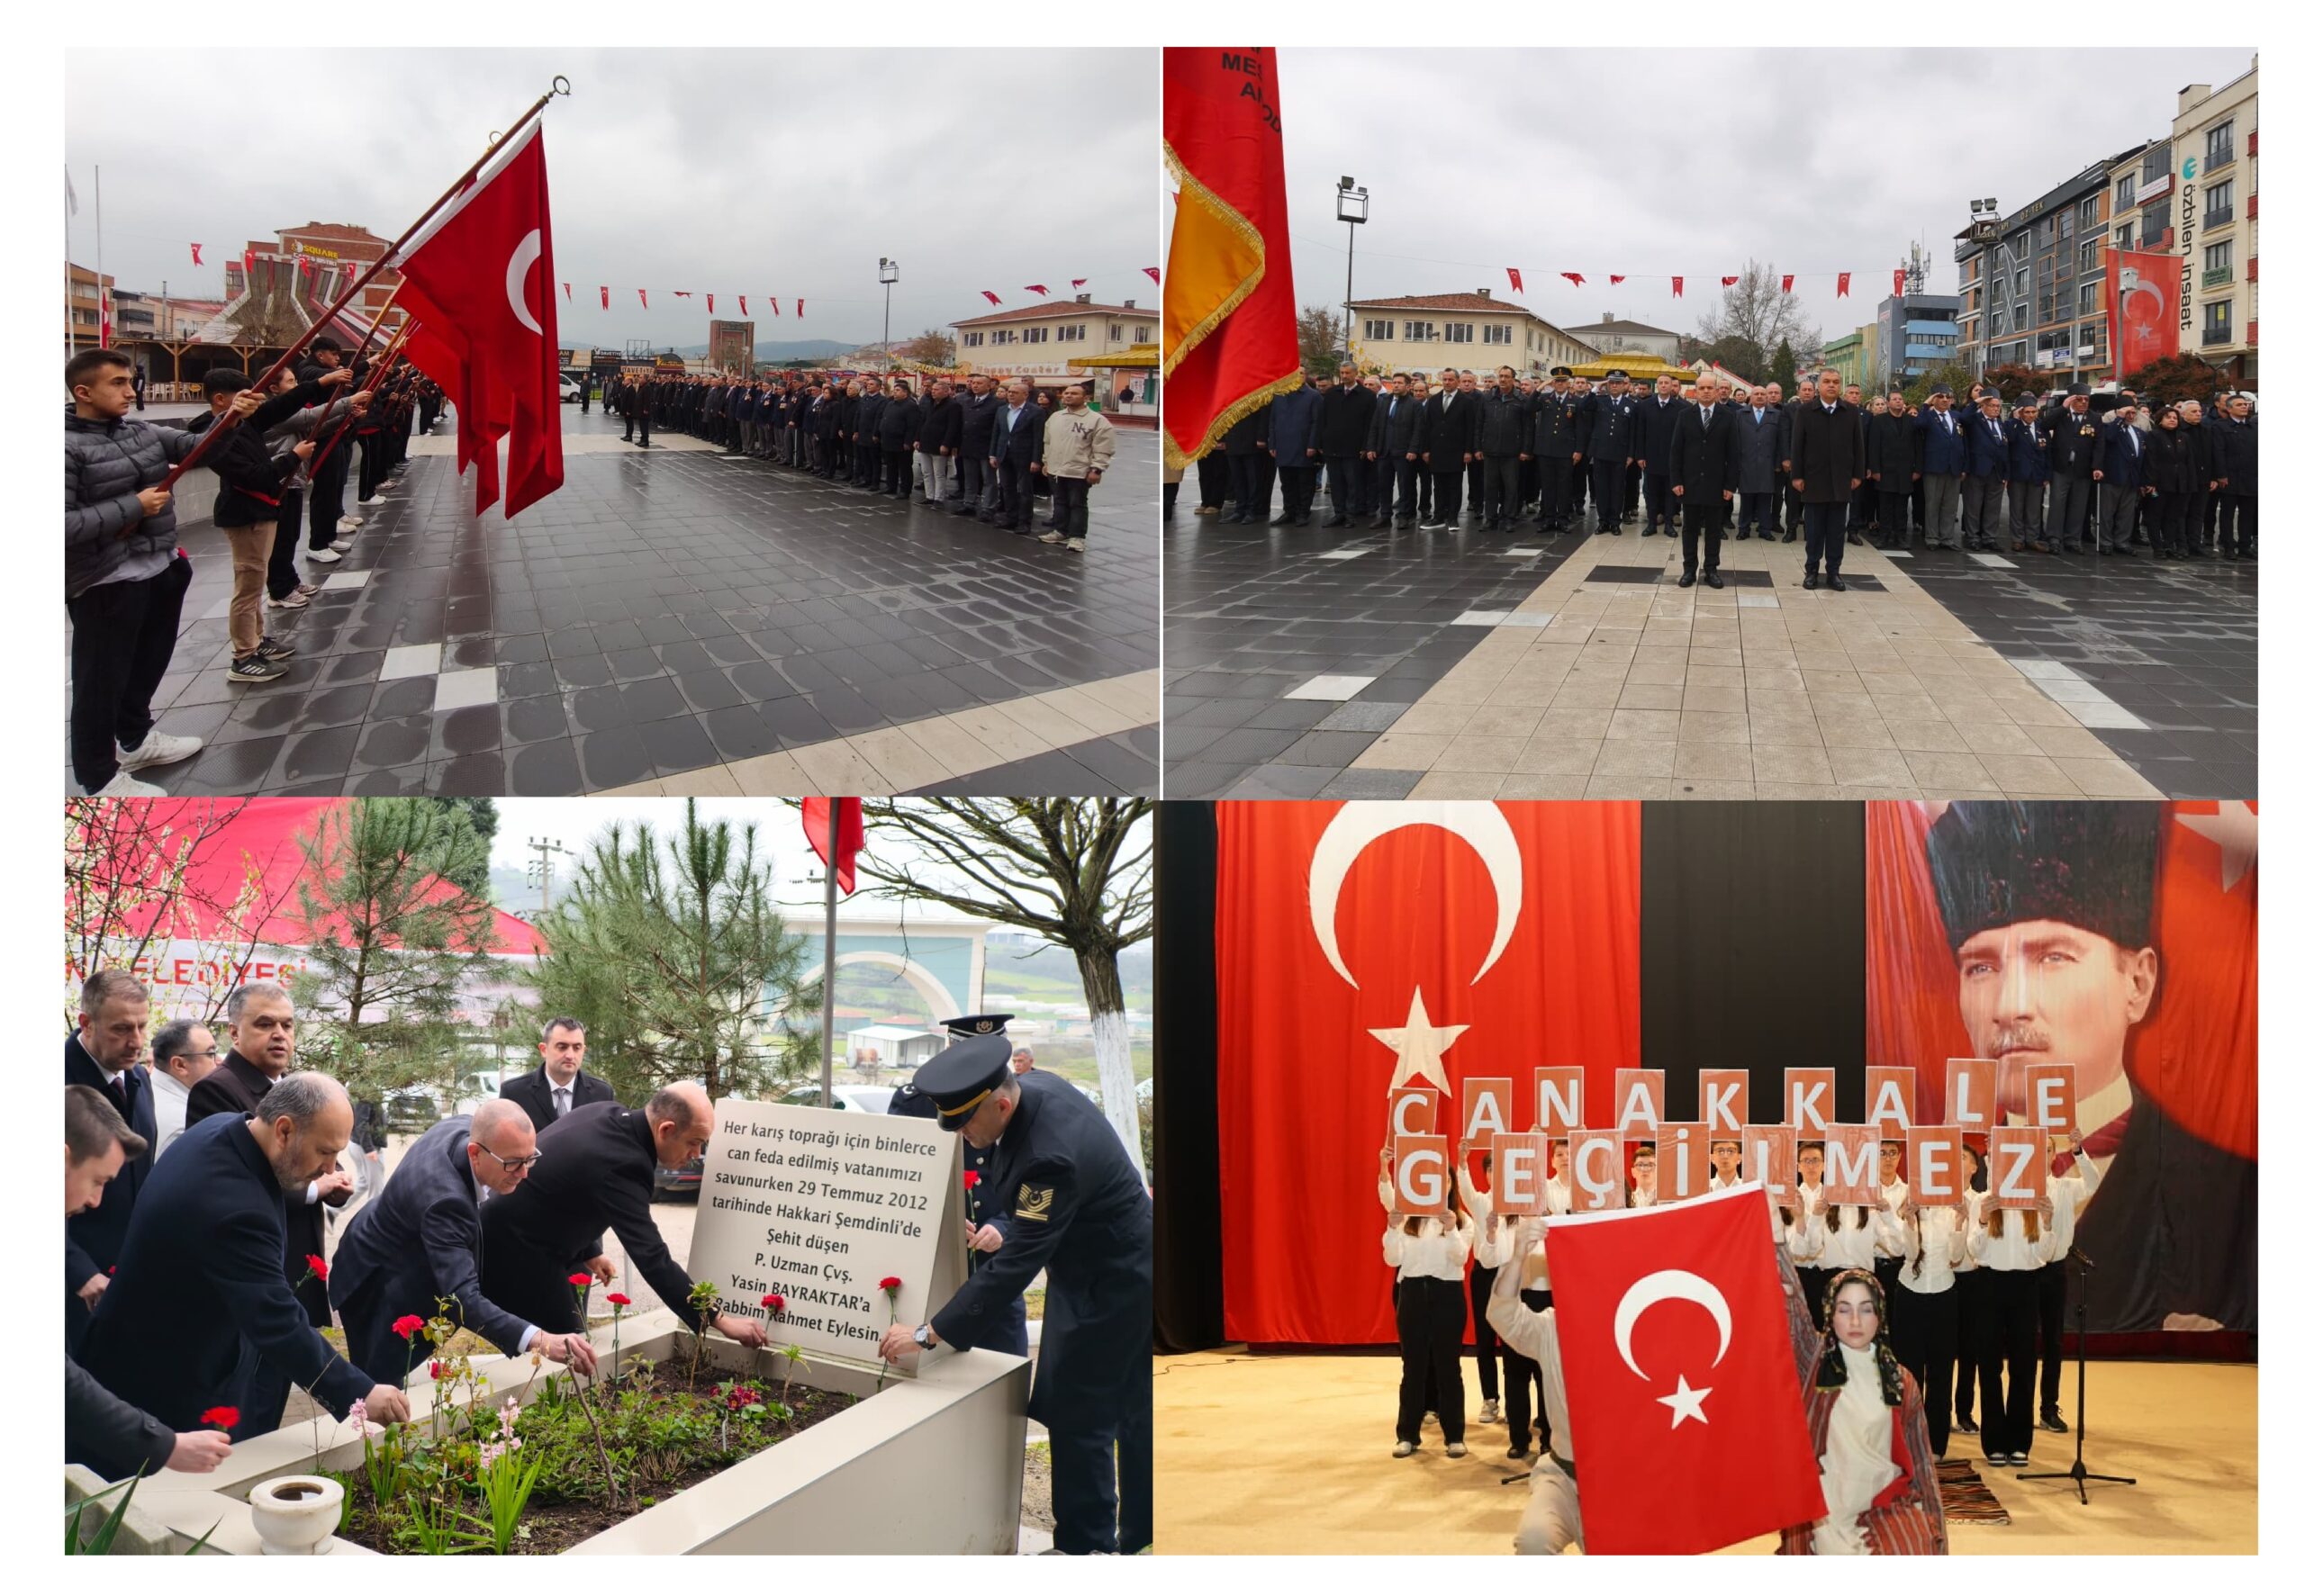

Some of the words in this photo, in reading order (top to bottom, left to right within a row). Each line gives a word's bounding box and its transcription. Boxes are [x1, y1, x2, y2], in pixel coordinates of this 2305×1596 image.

[2182, 183, 2196, 256] özbilen
[303, 244, 339, 260] SQUARE
[1071, 421, 1094, 440] NY
[724, 1121, 747, 1134] Her
[752, 1123, 783, 1142] karış
[790, 1129, 839, 1148] toprağı
[845, 1132, 870, 1150] için
[875, 1136, 936, 1156] binlerce
[728, 1150, 750, 1160] can
[755, 1149, 783, 1165] feda
[789, 1154, 839, 1175] edilmiş
[845, 1163, 922, 1182] vatanımızı
[1397, 1128, 2035, 1208] GEÇİLMEZ
[715, 1173, 792, 1192] savunurken
[798, 1180, 816, 1195] 29
[821, 1184, 883, 1204] Temmuz
[889, 1193, 927, 1210] 2012
[713, 1196, 772, 1215] tarihinde
[777, 1204, 831, 1224] Hakkari
[835, 1213, 921, 1237] Şemdinli'de
[766, 1229, 801, 1246] Şehit
[806, 1234, 848, 1254] düşen
[755, 1253, 765, 1267] P.
[772, 1255, 818, 1276] Uzman
[824, 1265, 852, 1284] Çvş.
[732, 1275, 766, 1293] Yasin
[772, 1281, 870, 1312] BAYRAKTAR'a
[827, 1319, 881, 1342] Eylesin.
